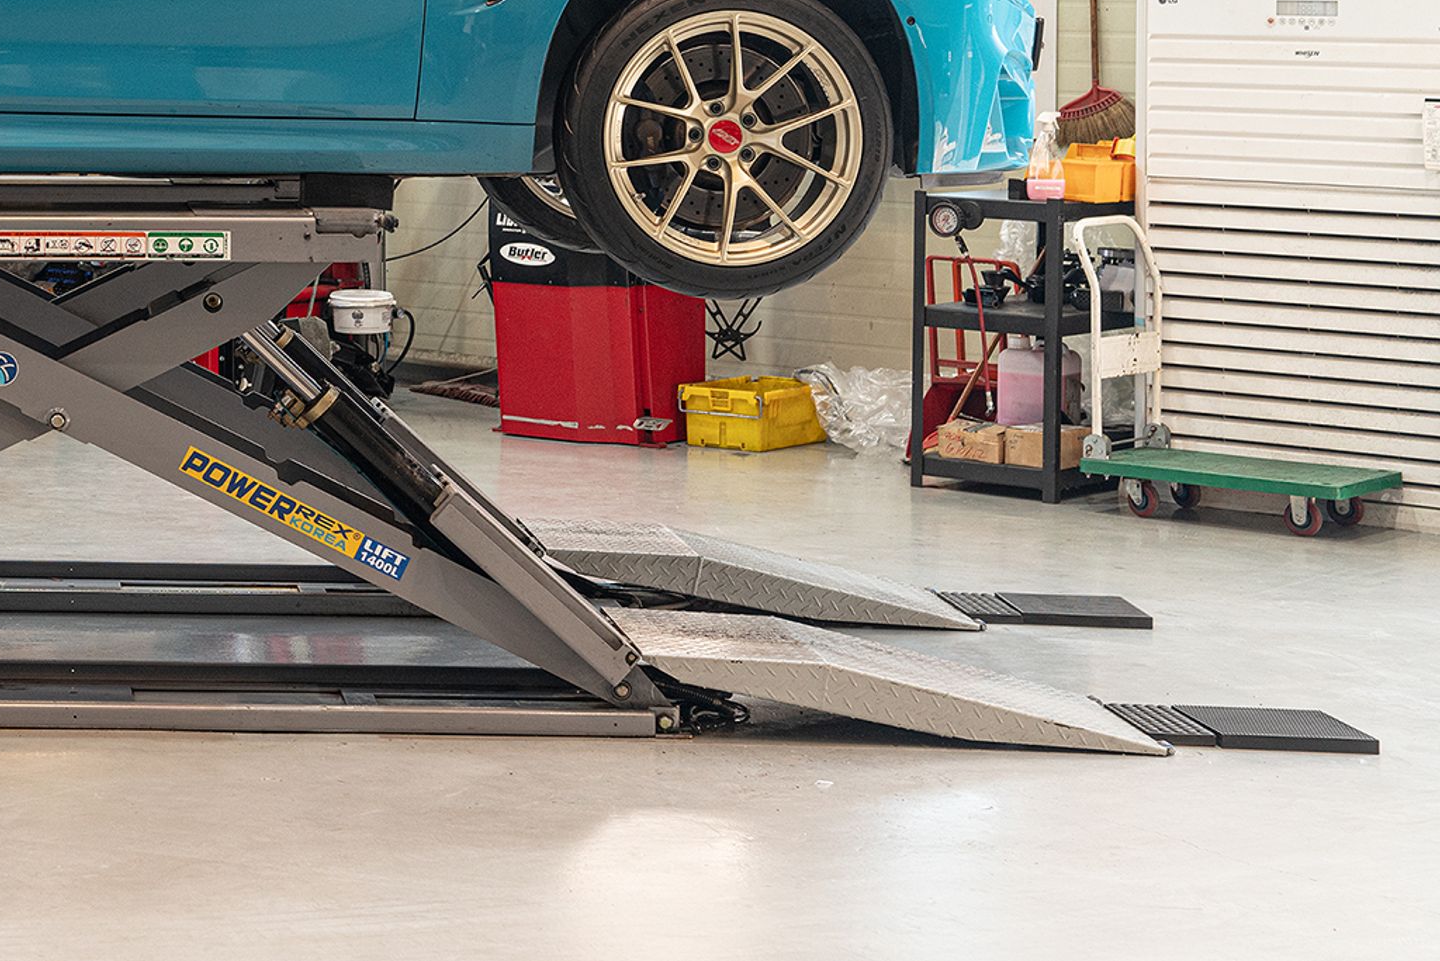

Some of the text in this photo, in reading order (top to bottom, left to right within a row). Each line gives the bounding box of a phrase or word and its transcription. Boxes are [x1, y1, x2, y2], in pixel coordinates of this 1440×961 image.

[508, 246, 548, 260] Butler
[181, 451, 296, 521] POWER
[290, 516, 346, 552] KOREA
[360, 551, 399, 578] 1400L
[363, 538, 408, 566] LIFT
